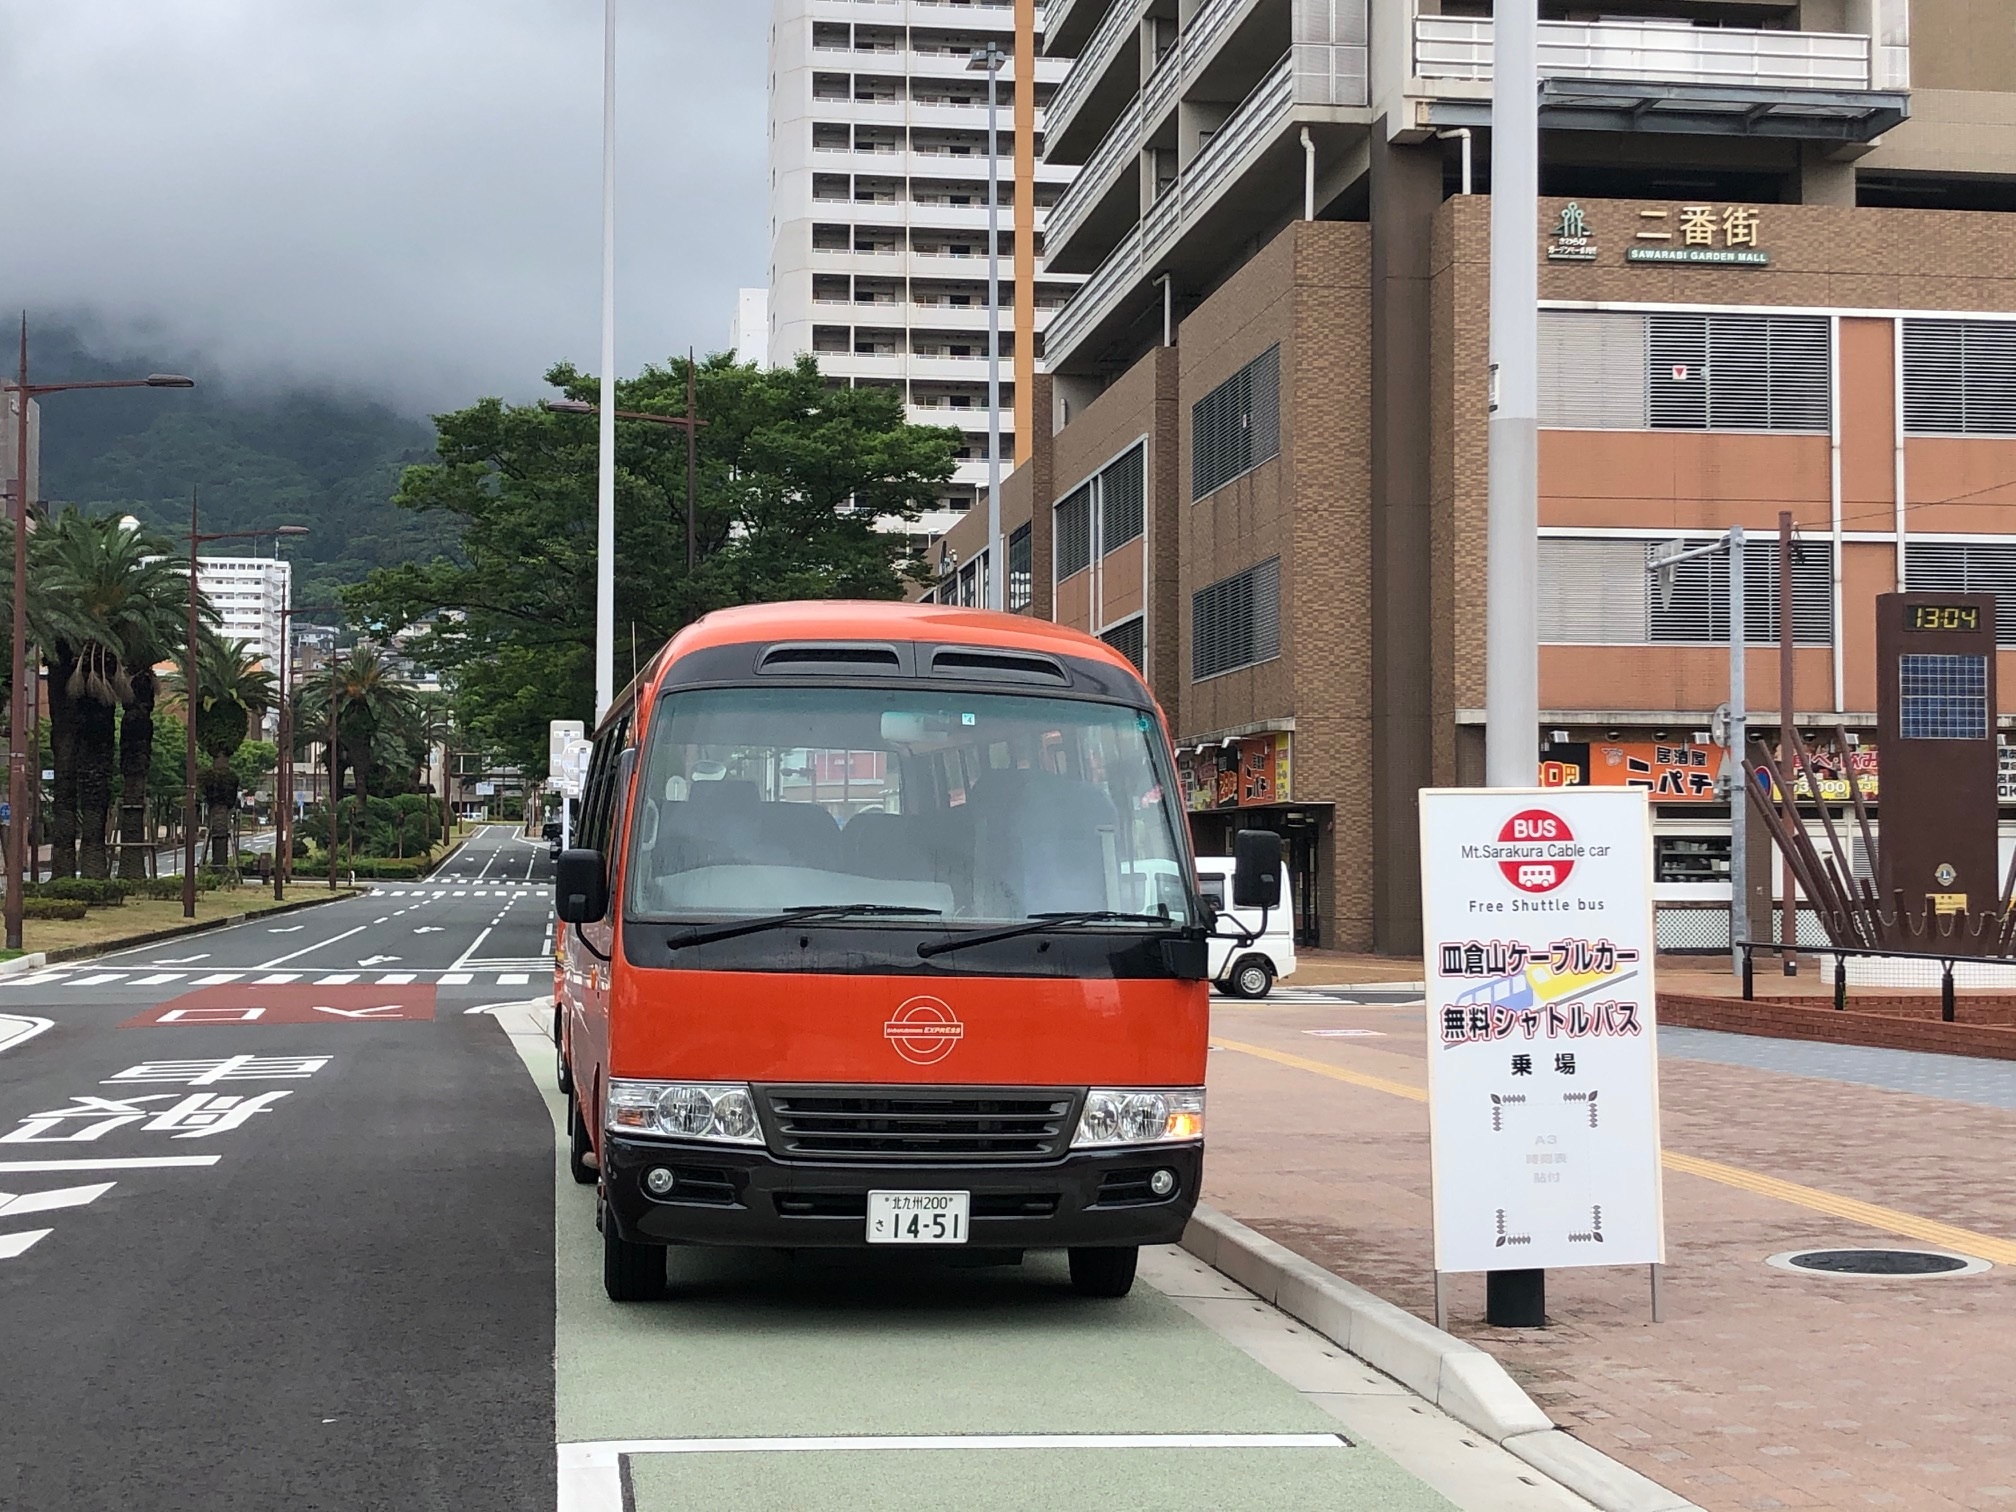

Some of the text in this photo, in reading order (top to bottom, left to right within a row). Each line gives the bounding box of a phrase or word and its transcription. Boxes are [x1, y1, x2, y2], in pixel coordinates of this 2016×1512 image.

[1636, 206, 1760, 246] 二番街
[1631, 249, 1766, 262] SAWARABI GARDEN MALL
[1916, 607, 1977, 629] 13:04
[1513, 819, 1557, 838] BUS
[1547, 844, 1586, 857] Cable
[1589, 845, 1611, 857] car
[1469, 899, 1605, 912] Free Shuttle bus
[1440, 939, 1638, 977] 皿倉山ケーブルカー
[923, 1026, 961, 1034] EXPRESS
[1441, 1002, 1641, 1041] 無料シャトルバス
[875, 1213, 959, 1239] さ 14-51
